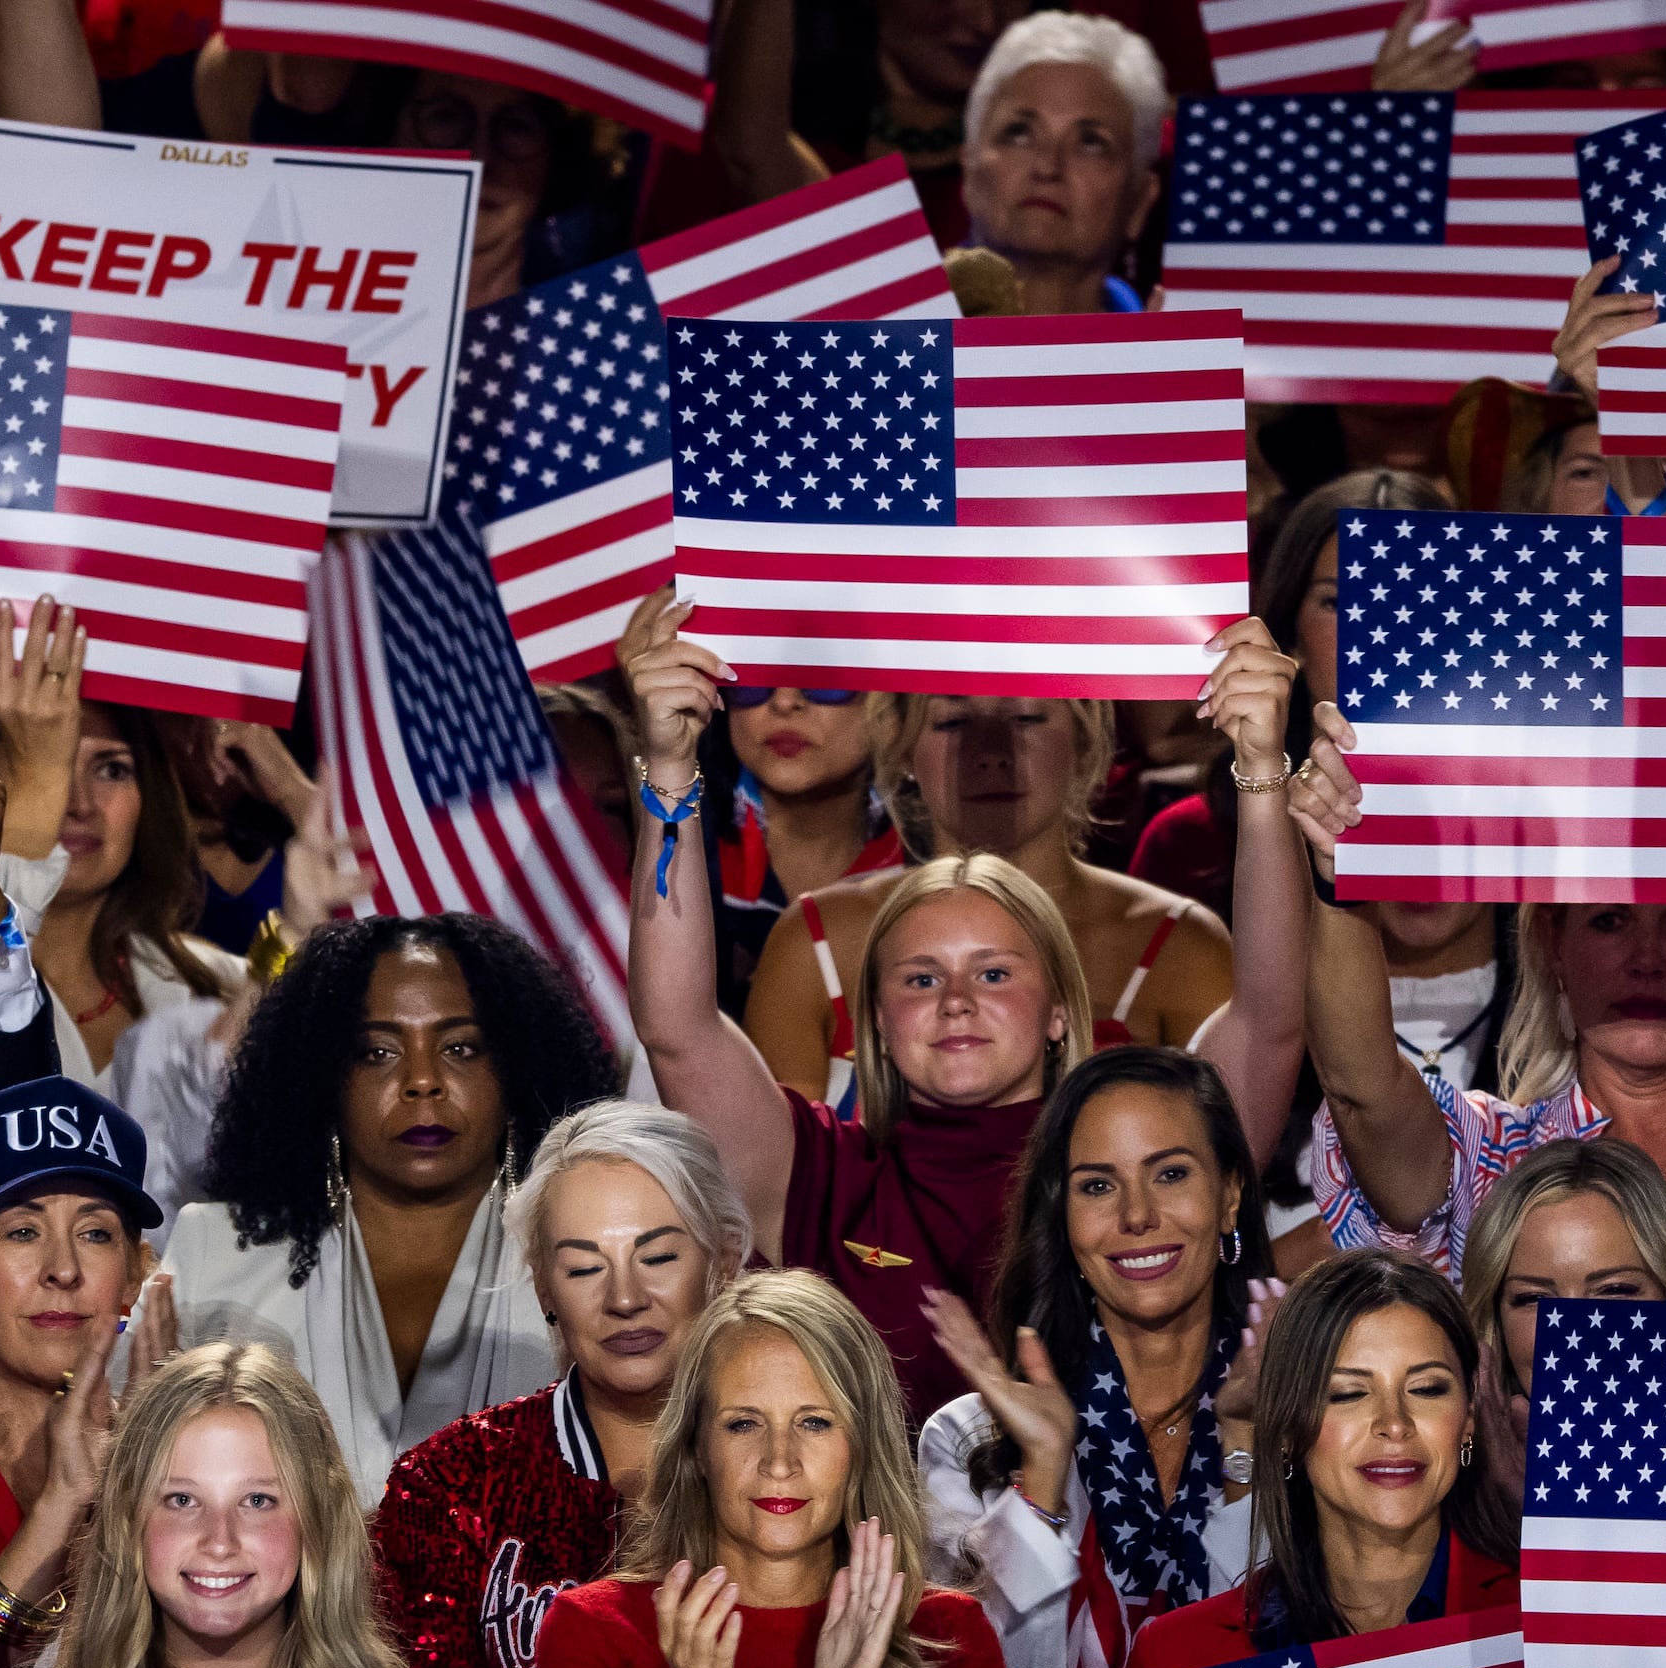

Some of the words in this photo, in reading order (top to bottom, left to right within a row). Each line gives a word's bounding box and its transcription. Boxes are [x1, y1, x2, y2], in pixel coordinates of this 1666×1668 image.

[160, 144, 249, 169] DALLAS
[241, 241, 419, 315] THE
[0, 1105, 123, 1168] USA
